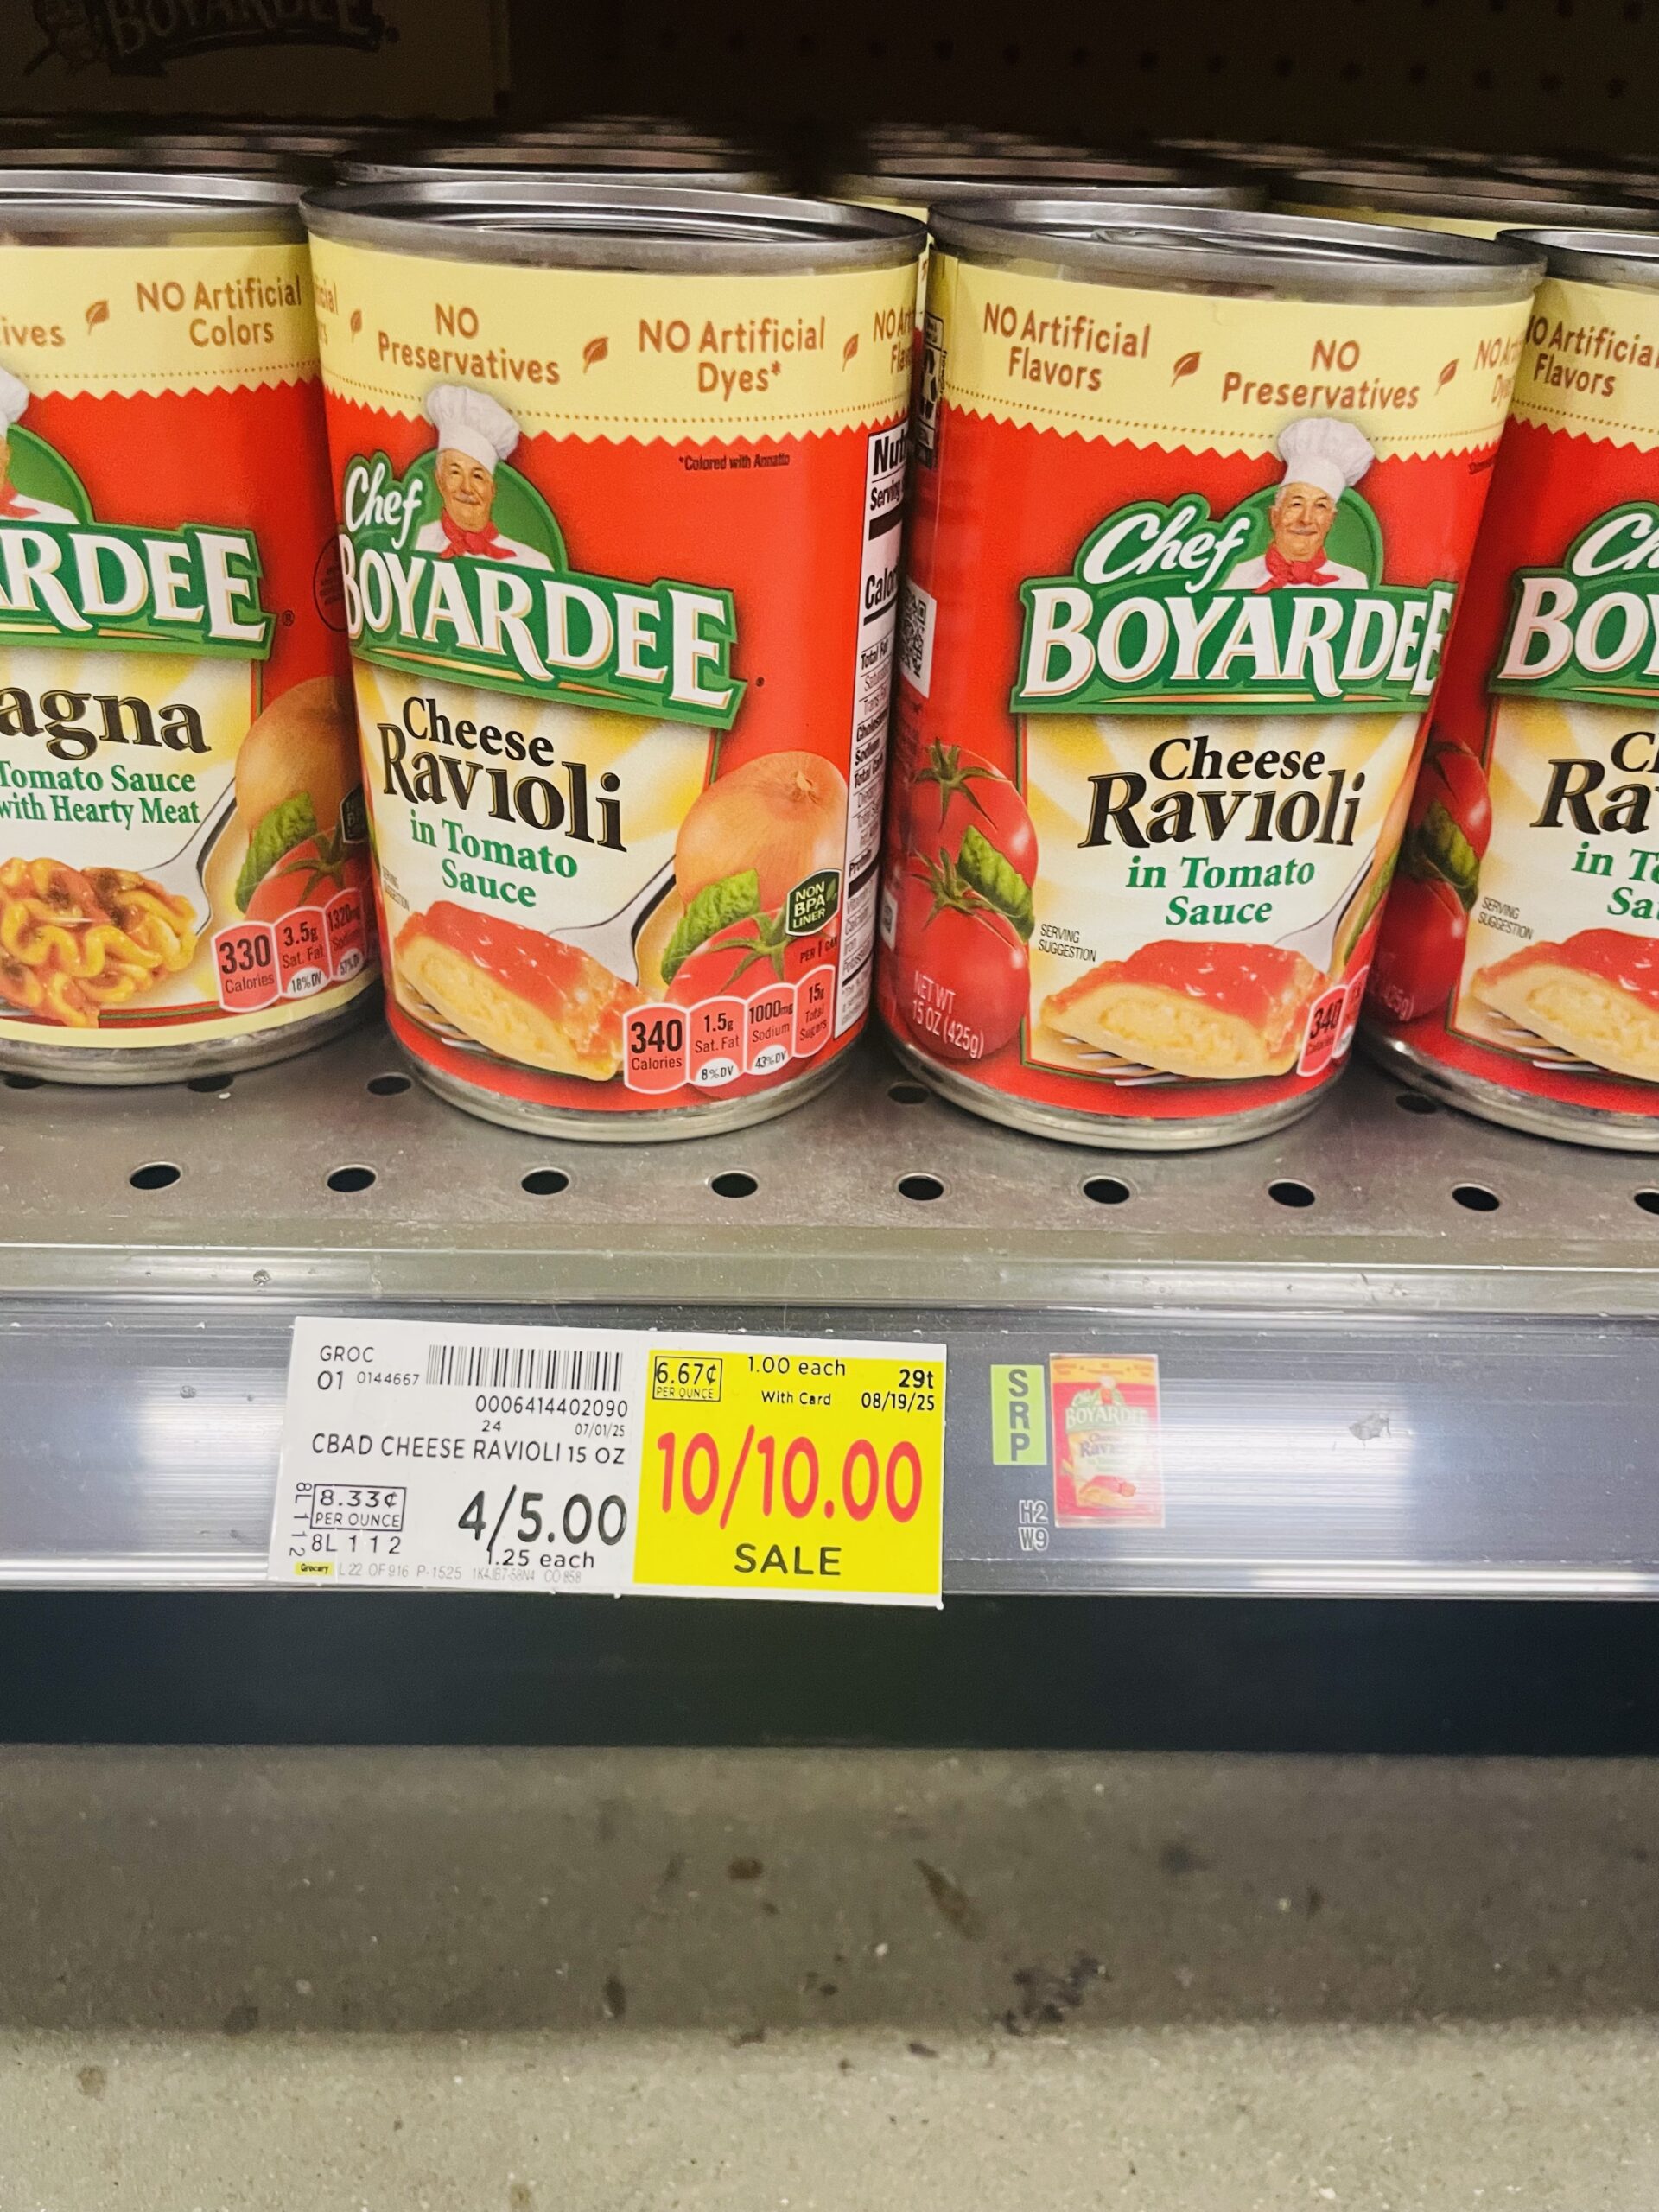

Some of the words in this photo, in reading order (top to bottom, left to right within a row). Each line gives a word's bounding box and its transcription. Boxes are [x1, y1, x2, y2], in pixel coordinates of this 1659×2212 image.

[137, 283, 185, 313] NO
[194, 276, 302, 311] Artificial
[189, 318, 274, 347] Colors
[435, 303, 479, 339] NO
[639, 319, 690, 353] NO
[698, 316, 825, 354] Artificial
[873, 308, 895, 342] NO
[983, 302, 1017, 338] NO
[1021, 309, 1150, 359] Artificial
[378, 330, 561, 385] Preservatives
[1008, 346, 1102, 391] Flavors
[1311, 340, 1360, 372] NO
[1473, 337, 1502, 371] NO
[1533, 353, 1616, 397] Flavors
[1222, 372, 1420, 410] Preservatives
[729, 454, 752, 468] with
[346, 462, 422, 549] Chef
[1083, 505, 1250, 594] Chef
[339, 533, 734, 709] BOYARDEE
[1497, 577, 1659, 680] BO
[1019, 587, 1454, 696] BOYARDEE
[403, 696, 554, 767] Cheese
[1149, 734, 1325, 781] Cheese
[1611, 731, 1659, 774] C
[0, 760, 103, 791] Tomato
[111, 765, 196, 792] Sauce
[377, 722, 627, 853] Ravioli
[0, 792, 48, 820] with
[49, 795, 134, 830] Hearty
[141, 797, 200, 823] Meat
[1078, 768, 1366, 849] Ravioli
[1529, 758, 1659, 835] Ra
[410, 809, 437, 847] in
[442, 818, 578, 878] Tomato
[1126, 855, 1166, 888] in
[1181, 856, 1315, 889] Tomato
[1571, 841, 1614, 876] in
[442, 858, 537, 907] Sauce
[795, 881, 825, 901] NON
[794, 893, 825, 917] BPA
[1166, 896, 1273, 925] Sauce
[1481, 897, 1520, 920] SERVING
[1607, 887, 1659, 920] Sa
[792, 908, 825, 929] LINER
[1478, 912, 1534, 940] SUGGESTION
[283, 921, 318, 946] 3.5g
[1039, 924, 1080, 944] SERVING
[219, 934, 271, 975] 330
[283, 952, 304, 969] Sat.
[307, 944, 325, 961] Fat
[800, 948, 816, 963] PER
[1038, 938, 1097, 963] SUGGESTION
[226, 974, 275, 994] Calories
[808, 983, 825, 1004] 15g
[914, 970, 934, 1002] NET
[935, 983, 957, 1014] WT
[704, 1012, 734, 1033] 1.5g
[749, 1000, 793, 1024] 1000mg
[804, 1004, 824, 1024] Total
[1308, 998, 1344, 1039] 340
[631, 1019, 683, 1053] 340
[695, 1039, 718, 1053] Sat.
[721, 1034, 739, 1050] Fat
[752, 1023, 790, 1043] Sodium
[799, 1019, 828, 1041] Sugars
[913, 999, 925, 1025] 15
[925, 1007, 942, 1036] OZ
[943, 1014, 984, 1059] (425g)
[632, 1057, 683, 1071] Calories
[320, 1345, 374, 1363] GROC
[748, 1356, 790, 1374] 1.00
[798, 1359, 846, 1376] each
[317, 1370, 344, 1390] 01
[357, 1371, 420, 1386] 0144667
[656, 1362, 716, 1385] 6.67¢
[899, 1369, 934, 1389] 29t
[476, 1395, 628, 1418] 0006414402090
[657, 1386, 676, 1398] PER
[679, 1388, 713, 1400] OUNCE
[762, 1390, 793, 1404] With
[799, 1392, 831, 1406] Card
[861, 1391, 935, 1412] 08/19/25
[481, 1420, 502, 1433] 24
[575, 1423, 626, 1438] 07/01/25
[312, 1433, 372, 1455] CBAD
[381, 1436, 465, 1459] CHEESE
[473, 1440, 560, 1462] RAVIOLI
[568, 1446, 587, 1464] 15
[594, 1448, 625, 1465] OZ
[657, 1424, 923, 1530] 10/10.00
[319, 1489, 398, 1508] 8.33¢
[1019, 1500, 1049, 1524] H2
[315, 1512, 343, 1524] PER
[348, 1513, 401, 1528] OUNCE
[457, 1484, 628, 1552] 4/5.00
[312, 1534, 338, 1552] 8L
[349, 1535, 357, 1553] 1
[370, 1535, 378, 1554] 1
[389, 1536, 401, 1554] 2
[1018, 1527, 1050, 1552] W9
[300, 1563, 329, 1574] Grocery
[348, 1562, 362, 1577] 22
[368, 1562, 385, 1578] OF
[389, 1564, 409, 1578] 916
[416, 1565, 462, 1580] P-1525
[486, 1548, 531, 1567] 1.25
[540, 1551, 595, 1569] each
[734, 1542, 842, 1576] SALE
